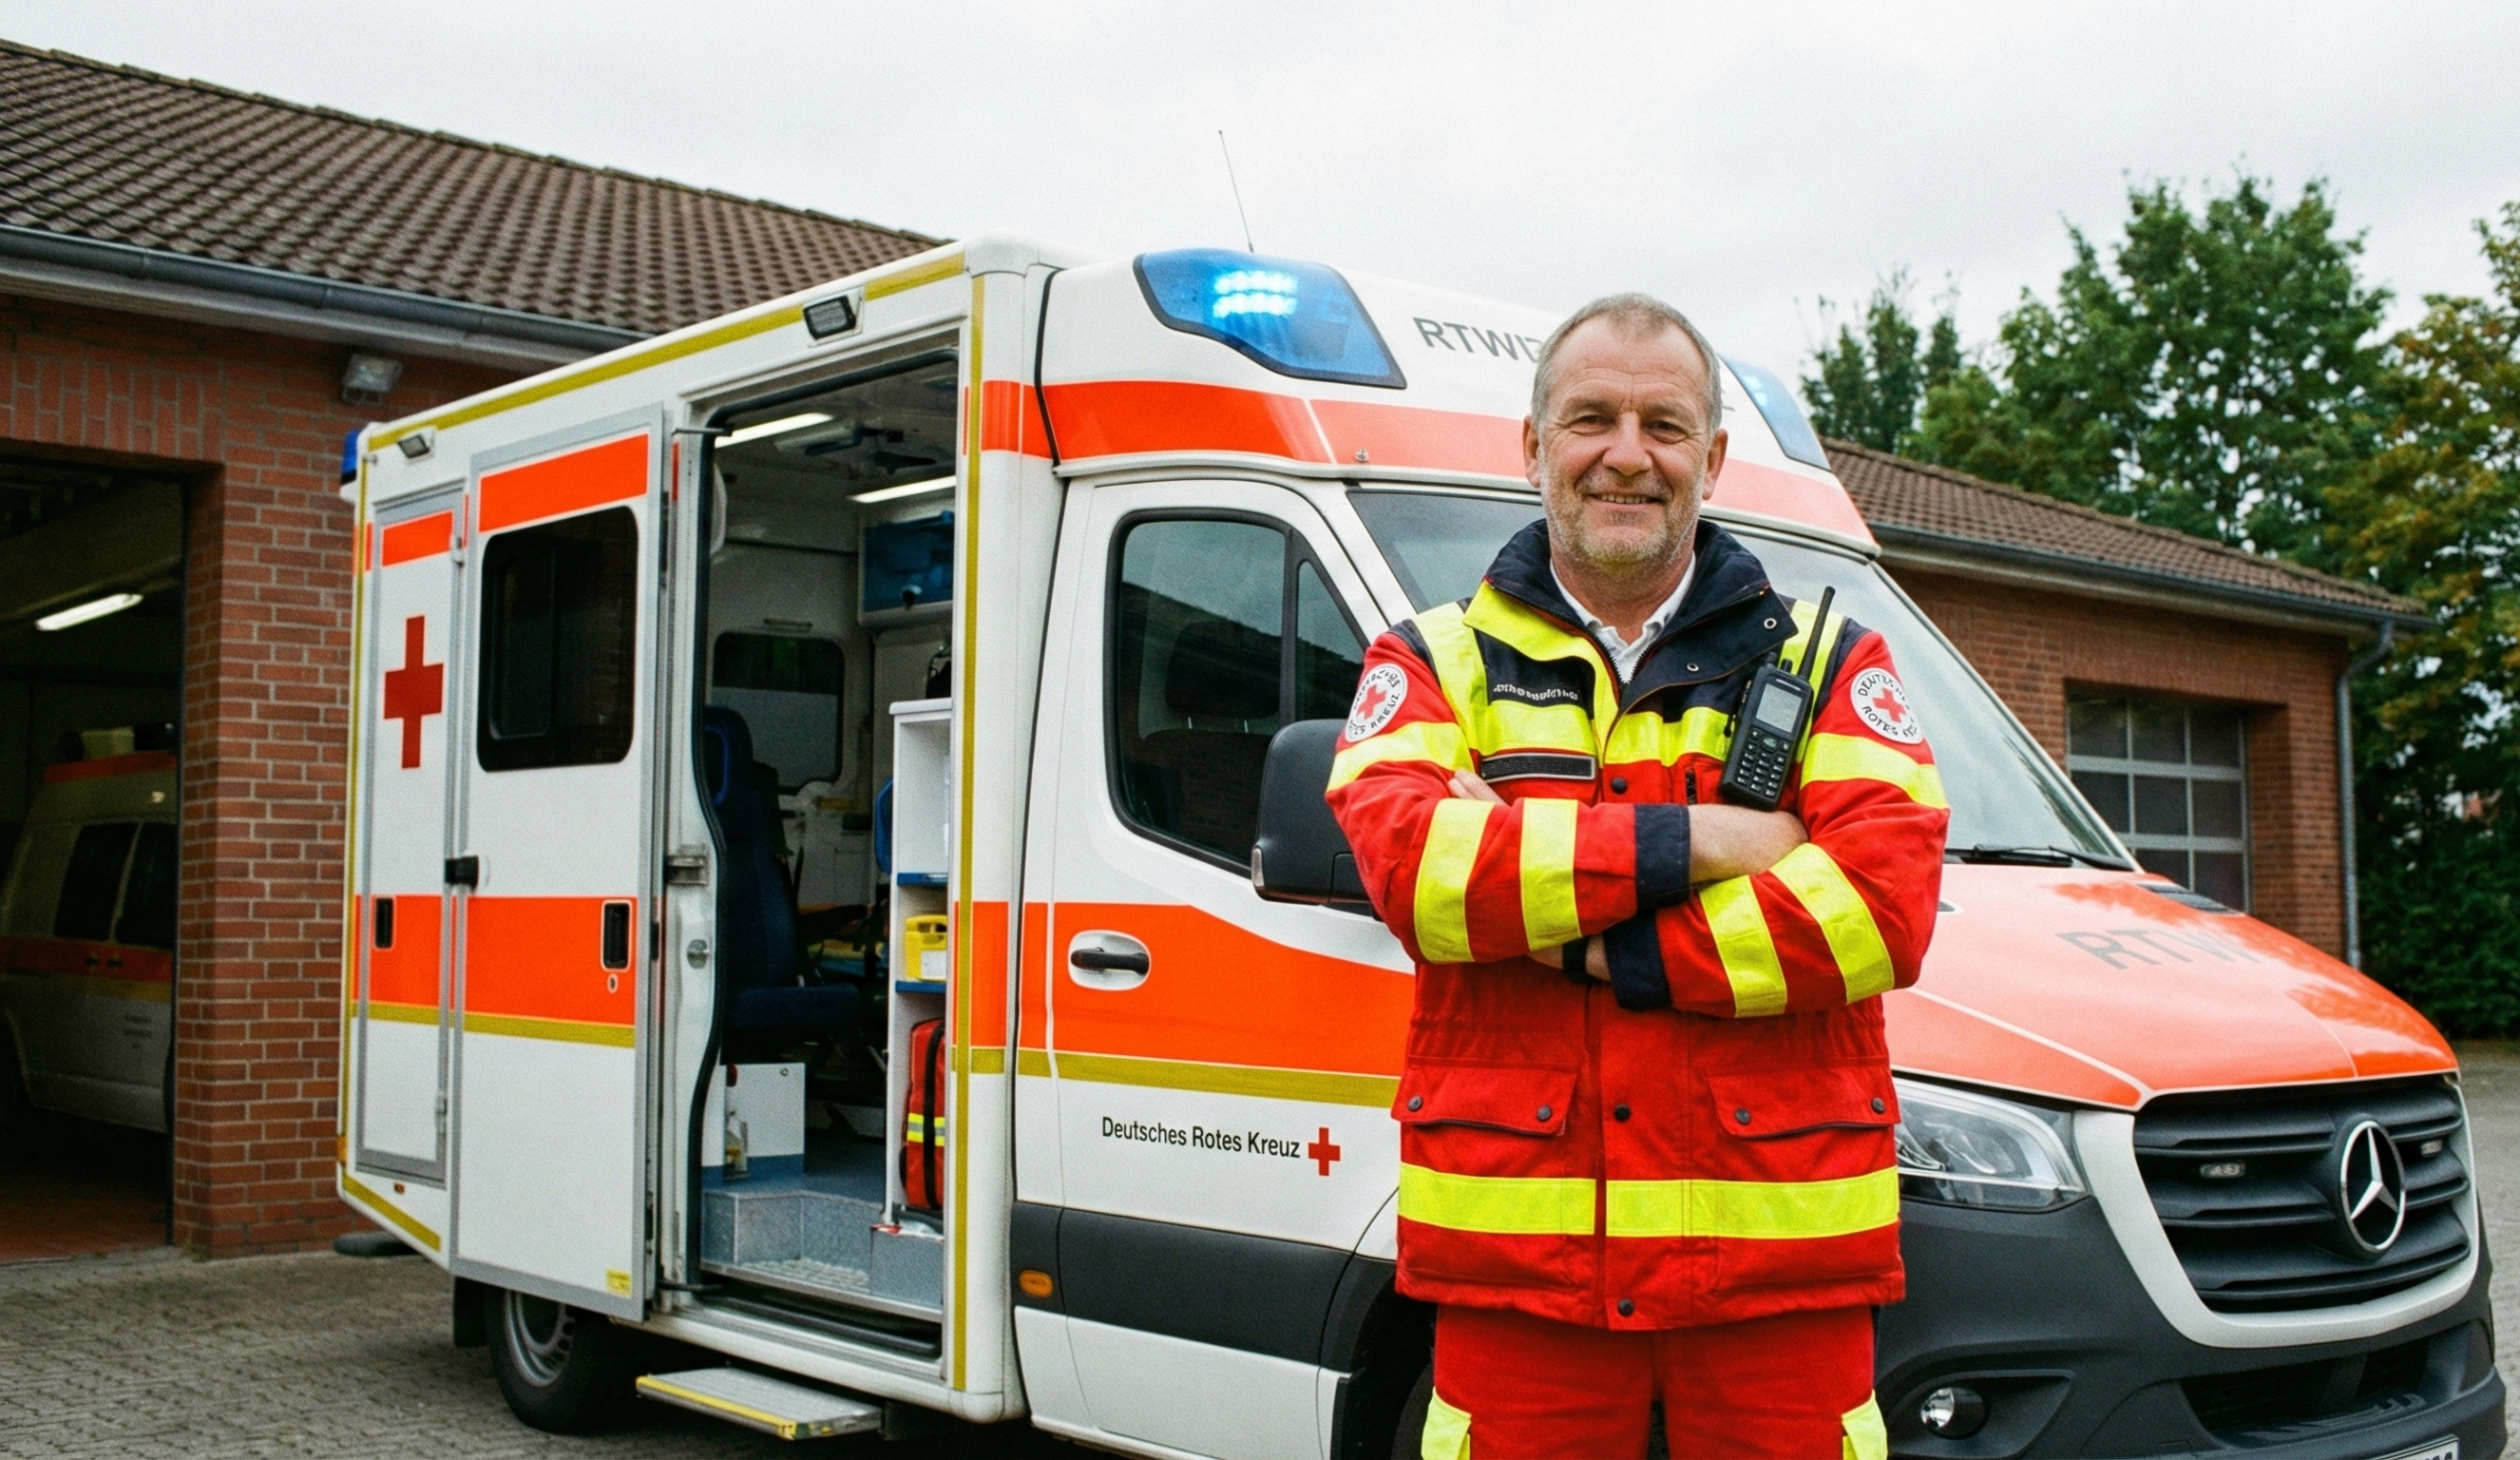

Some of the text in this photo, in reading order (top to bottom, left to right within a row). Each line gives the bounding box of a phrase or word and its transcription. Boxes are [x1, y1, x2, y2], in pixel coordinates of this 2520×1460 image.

[1102, 1116, 1301, 1159] Deutsches Rotes Kreuz
